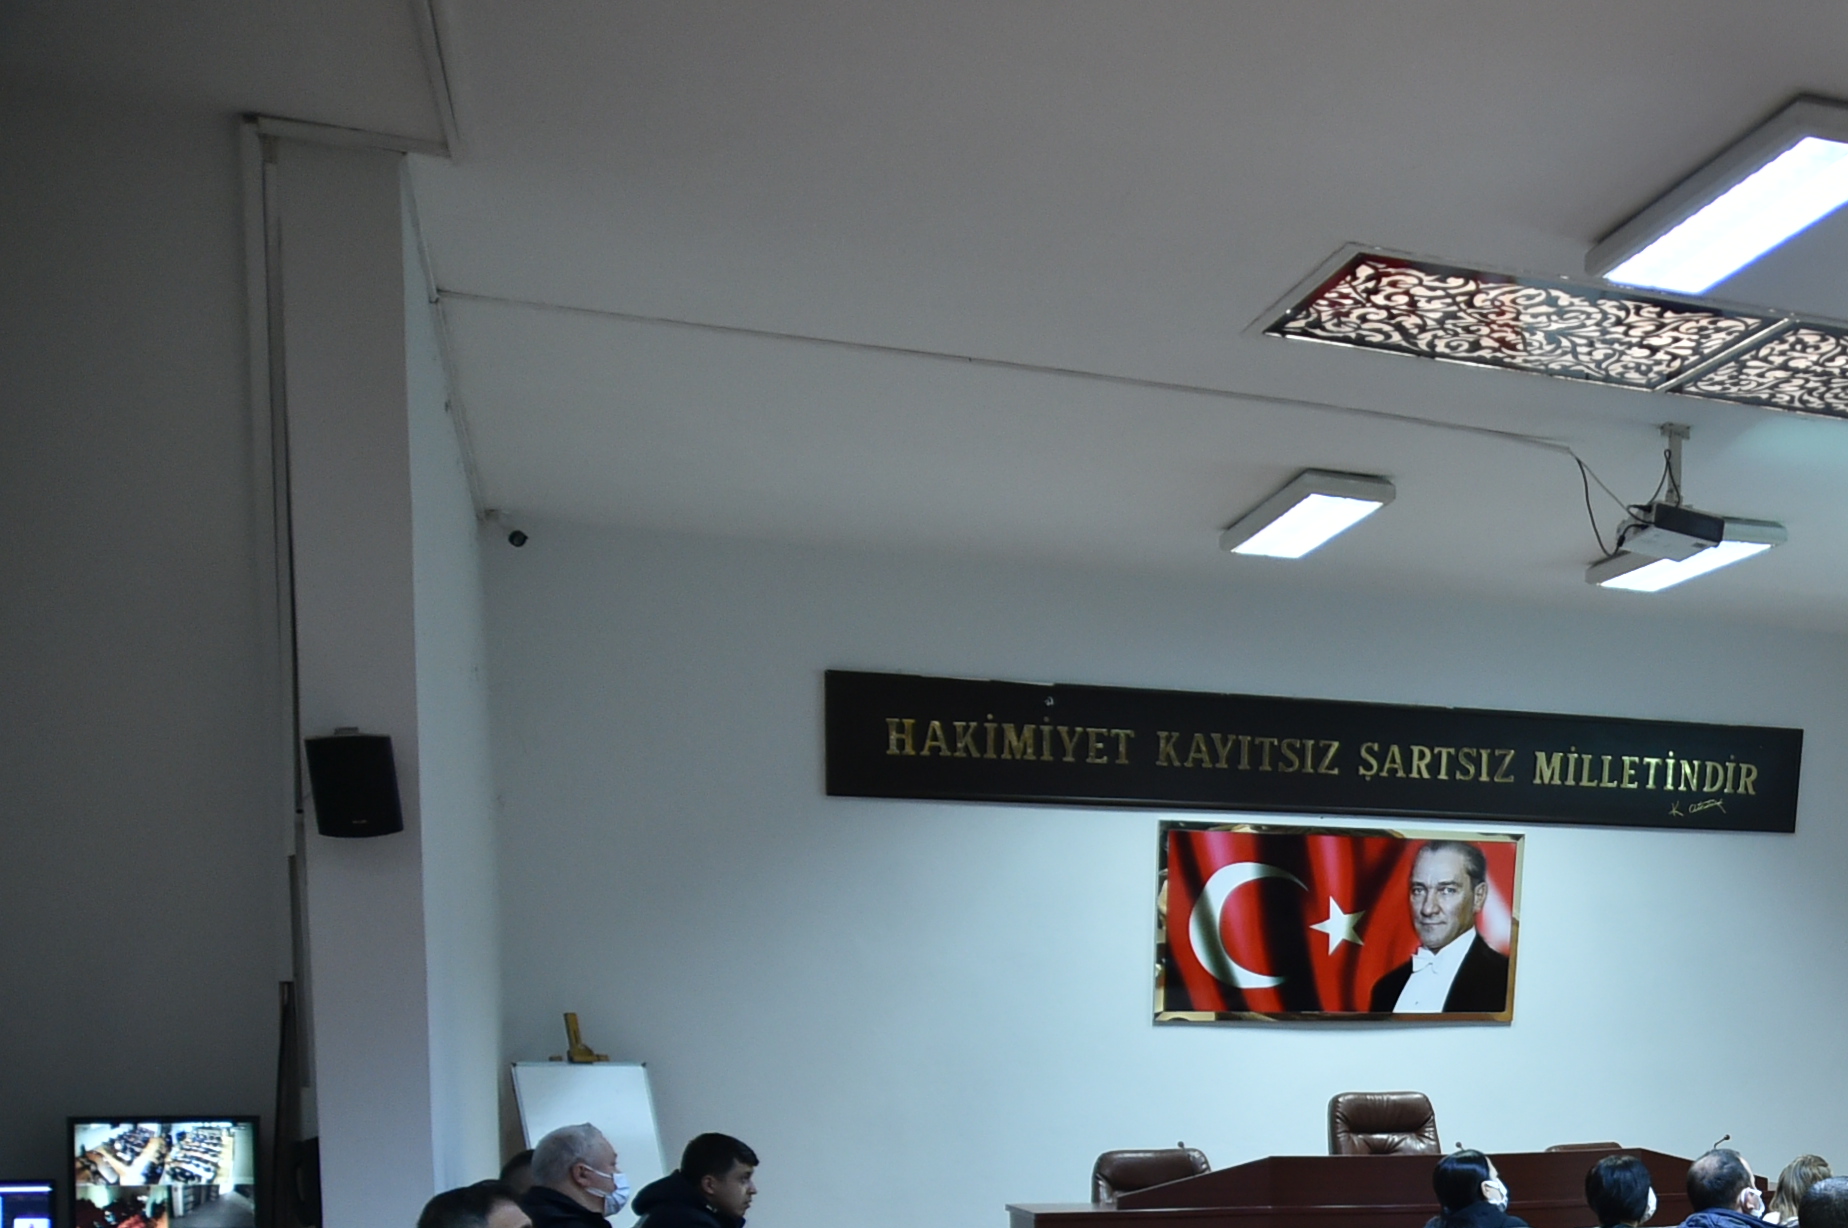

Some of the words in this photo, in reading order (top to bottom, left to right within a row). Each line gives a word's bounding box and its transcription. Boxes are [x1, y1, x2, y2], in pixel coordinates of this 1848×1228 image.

[885, 713, 1135, 765] HAKİMİYET
[1155, 731, 1340, 775] KAYITSIZ
[1358, 742, 1515, 781] ŞARTSIZ
[1532, 746, 1758, 795] MİLLETİNDİR
